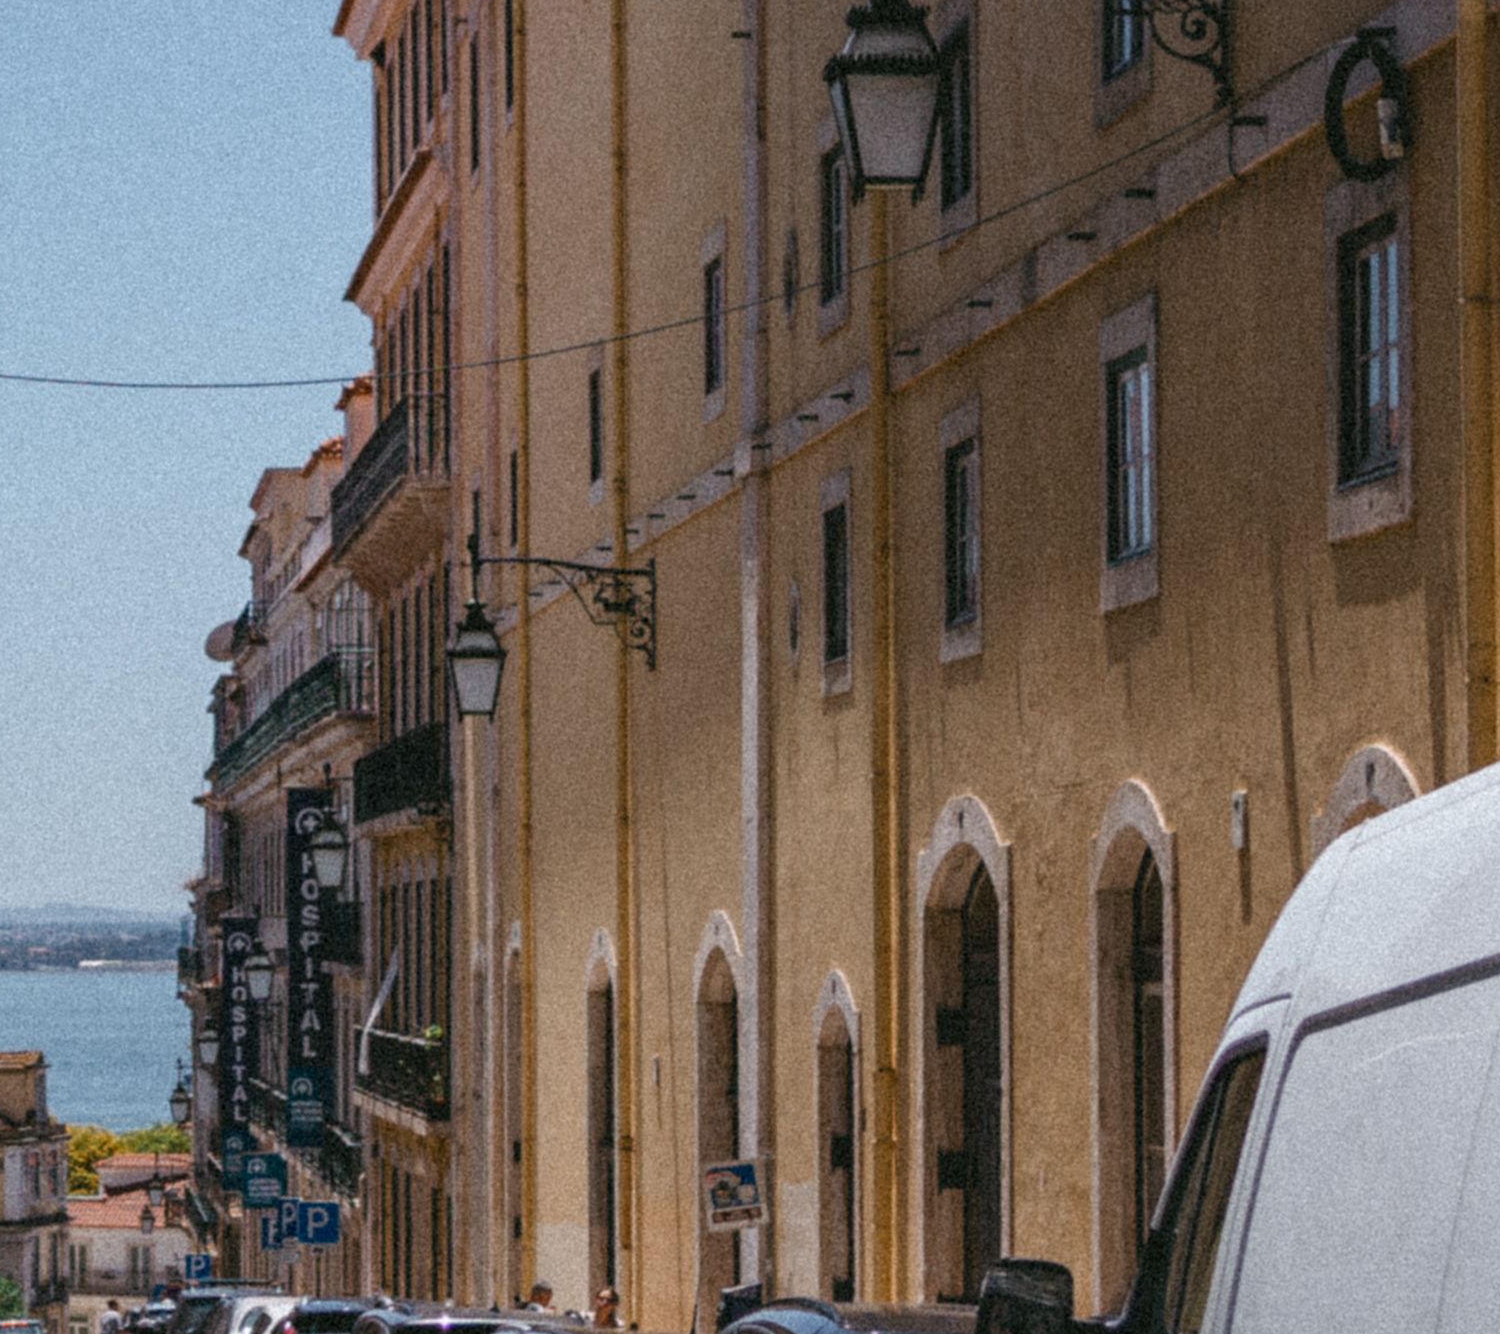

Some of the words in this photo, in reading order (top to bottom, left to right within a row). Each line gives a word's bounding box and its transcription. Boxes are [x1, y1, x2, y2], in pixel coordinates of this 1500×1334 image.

[301, 852, 321, 1058] HOSPITAL
[231, 966, 248, 1122] HOSPITAL
[306, 1207, 329, 1239] P
